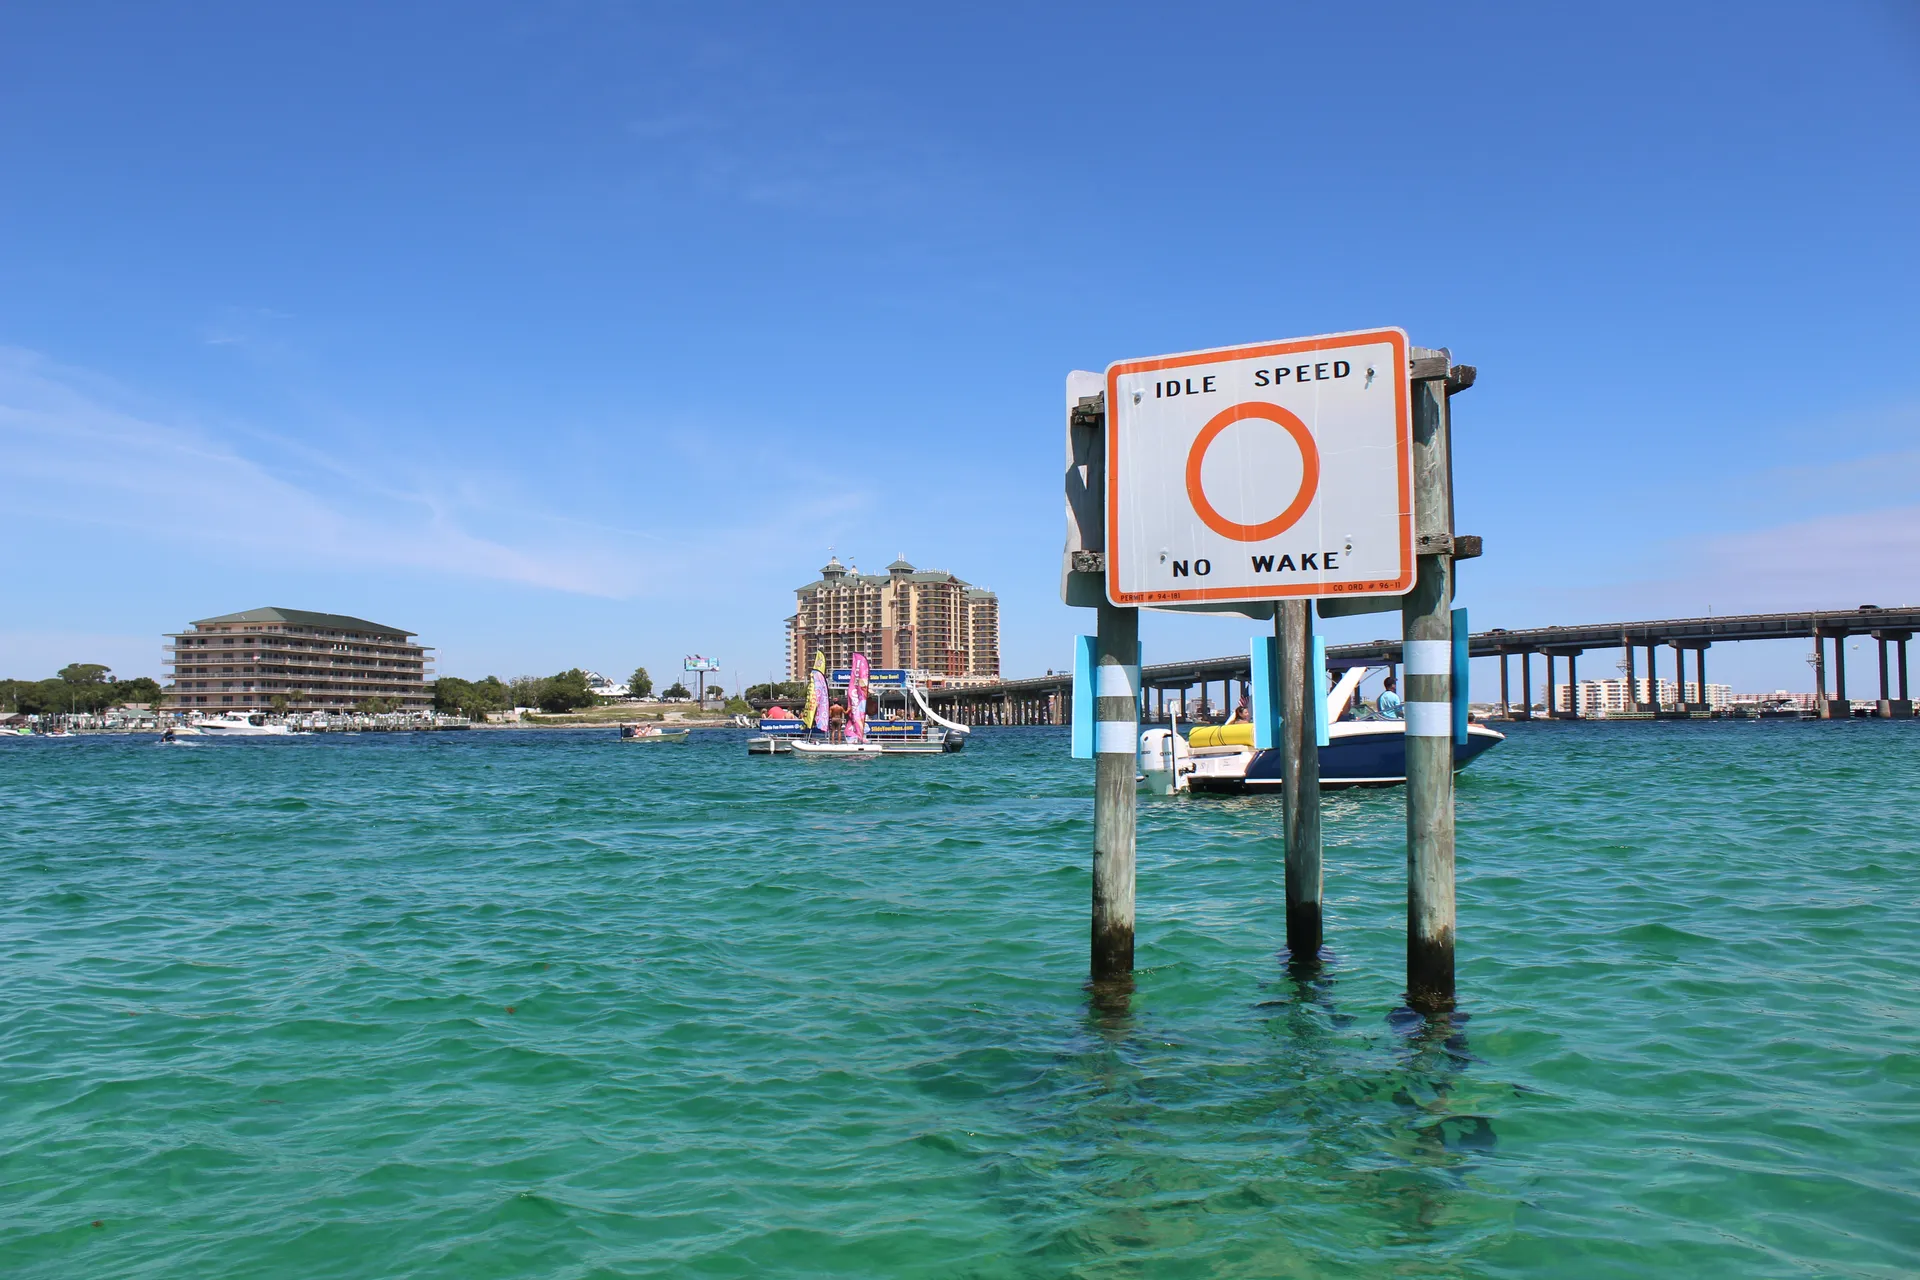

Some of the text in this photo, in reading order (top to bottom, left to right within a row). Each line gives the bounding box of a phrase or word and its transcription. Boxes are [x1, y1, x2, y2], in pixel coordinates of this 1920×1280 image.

[1156, 360, 1350, 399] IDLE SPEED
[1172, 552, 1339, 578] NO WAKE
